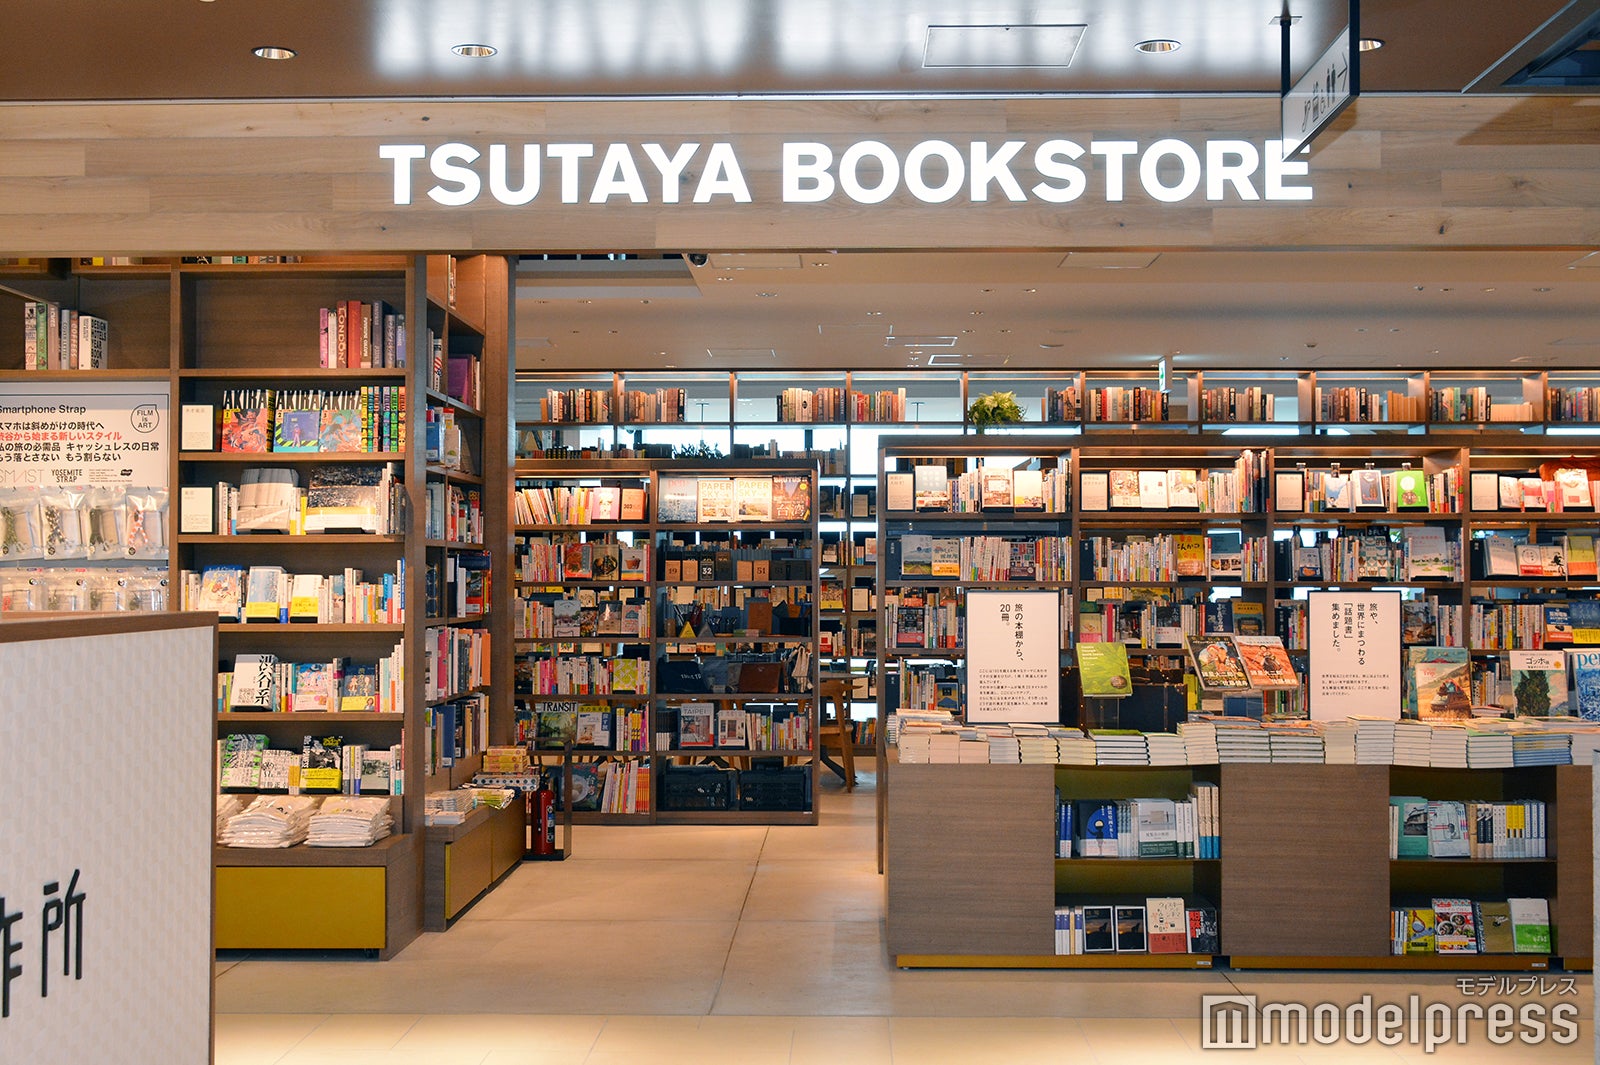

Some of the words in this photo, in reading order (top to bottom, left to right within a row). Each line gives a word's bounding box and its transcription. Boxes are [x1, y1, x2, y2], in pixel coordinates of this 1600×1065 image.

[379, 142, 752, 206] TSUTAYA
[783, 138, 1313, 204] BOOKSTORE
[223, 390, 267, 409] AKIRA
[275, 390, 320, 409] AKIRA
[321, 391, 362, 410] AKIRA
[59, 405, 86, 414] Strap
[66, 442, 160, 451] キャッシュレスの日常
[66, 452, 121, 462] もう割らない
[777, 503, 805, 517] 台湾
[702, 567, 713, 575] 32
[1344, 602, 1354, 639] 「話題書」
[1370, 603, 1378, 624] 旅や、
[1014, 604, 1024, 661] 旅の本棚から、
[1332, 603, 1340, 652] 集めました。
[1357, 603, 1366, 665] 世界にまつわる
[1576, 653, 1600, 670] pe
[254, 655, 273, 704] 渋谷系
[542, 701, 577, 712] TRANSIT
